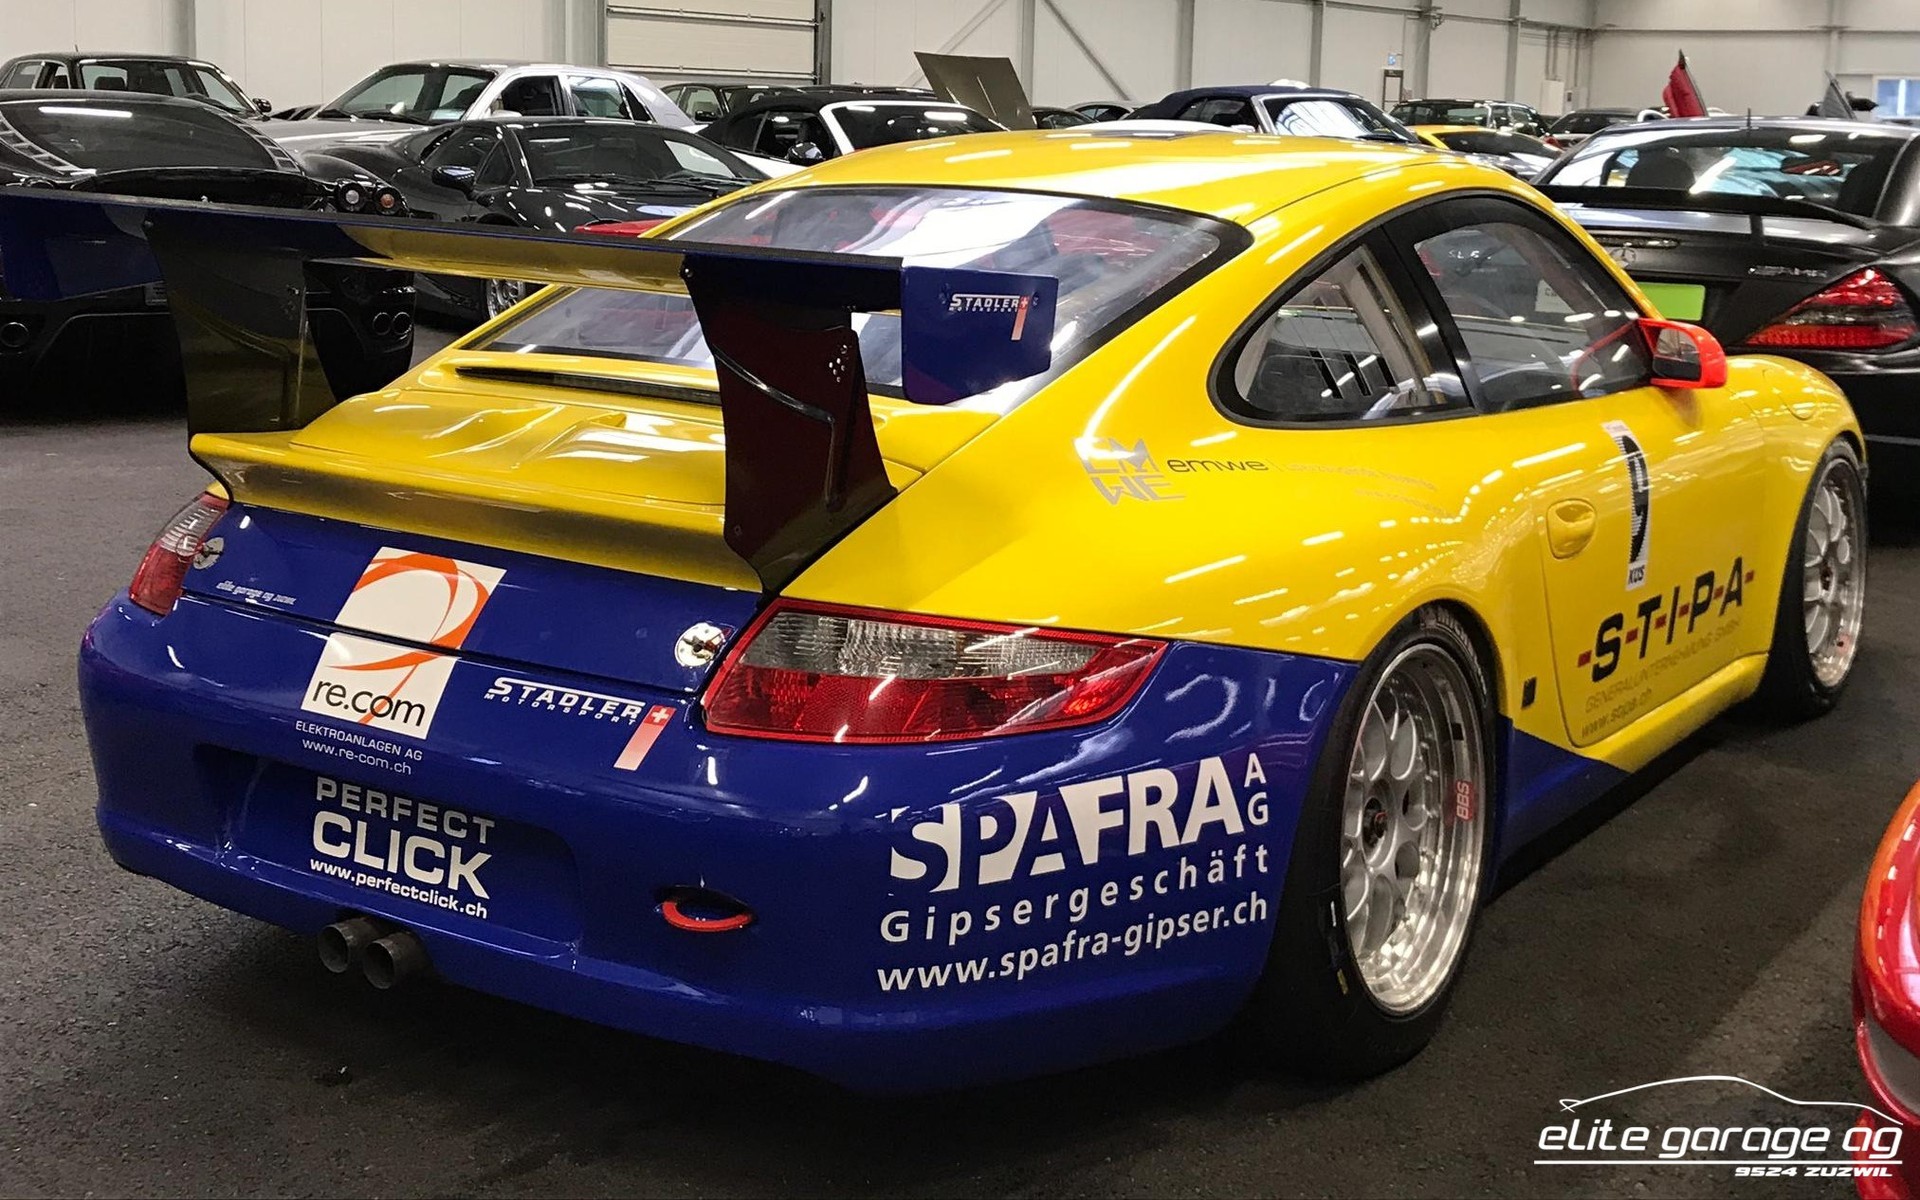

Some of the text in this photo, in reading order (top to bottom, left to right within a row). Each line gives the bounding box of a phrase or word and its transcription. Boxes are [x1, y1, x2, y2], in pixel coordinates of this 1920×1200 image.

[950, 293, 1020, 308] STADLER
[1167, 459, 1269, 473] emwe
[312, 680, 426, 726] re.com
[484, 693, 636, 726] MOTORSPORT
[487, 677, 646, 720] STADLER
[295, 720, 423, 761] ELEKTROANLAGEN AG
[302, 738, 412, 775] www.re-com.ch
[316, 776, 495, 844] PERFECT
[1456, 781, 1471, 820] BBS
[889, 755, 1245, 893] SPAFRA
[313, 810, 492, 900] CLICK
[310, 858, 488, 919] www.perfectclick.ch
[879, 843, 1269, 946] Gipsergeschäft
[877, 891, 1267, 991] www.spafra-gipser.ch
